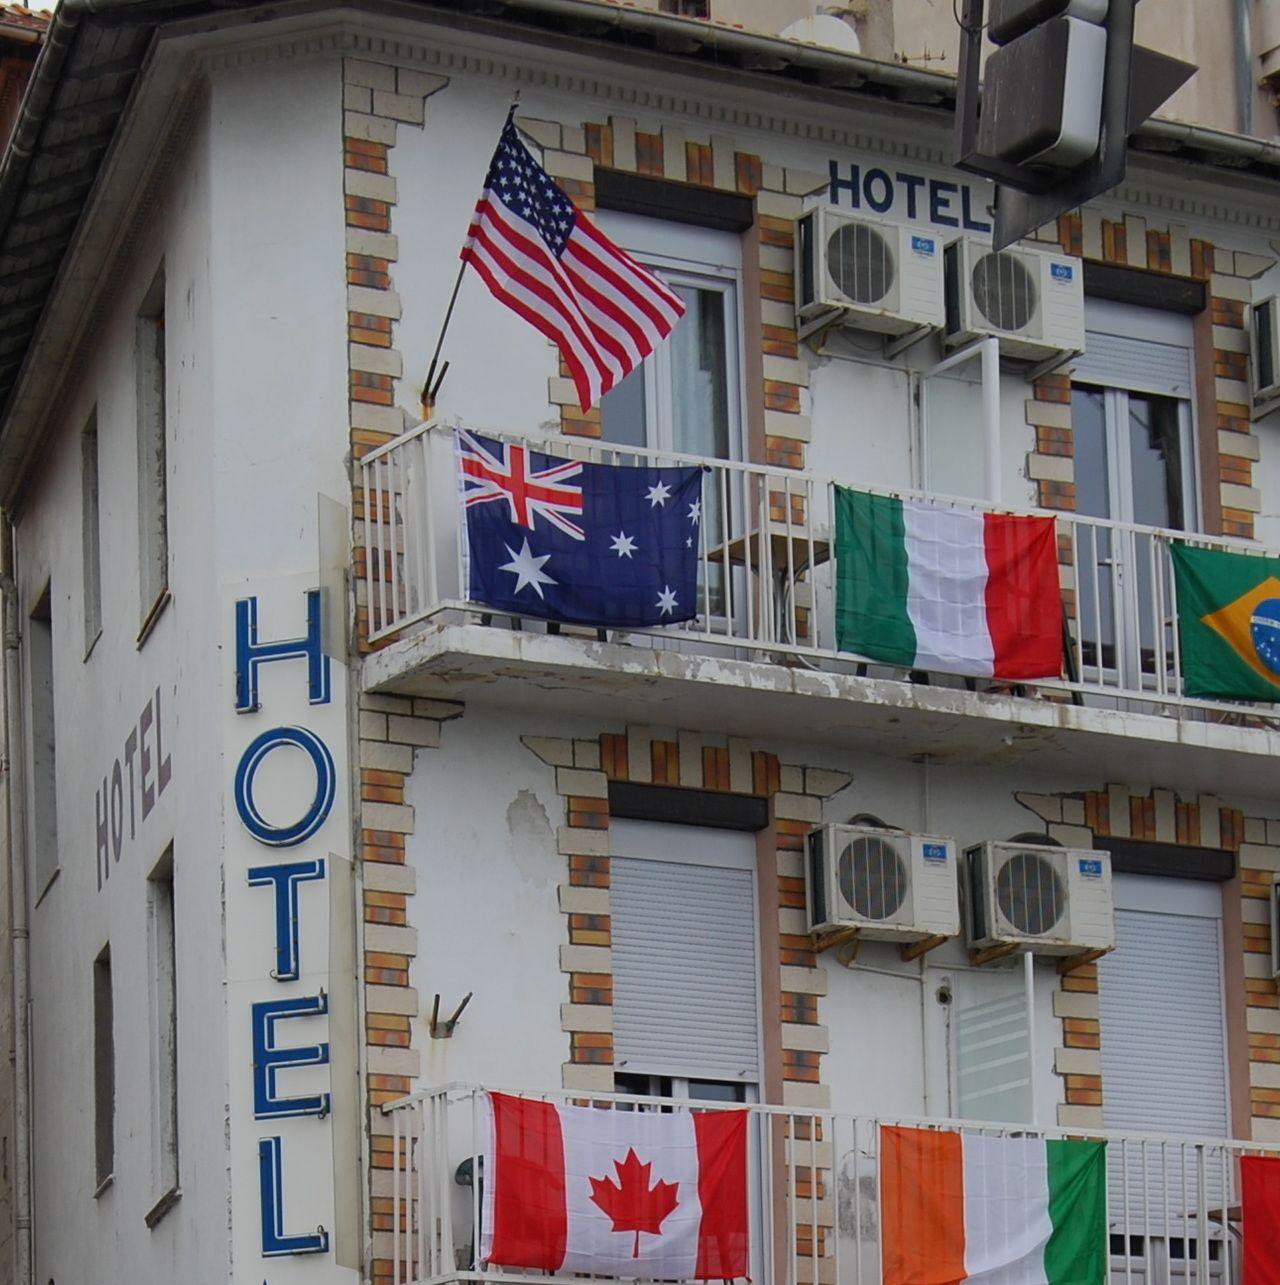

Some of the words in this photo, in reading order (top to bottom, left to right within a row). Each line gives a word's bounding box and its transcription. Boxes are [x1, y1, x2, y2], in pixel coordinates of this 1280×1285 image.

[829, 160, 991, 233] HOTEL
[96, 684, 171, 894] HOTEL
[235, 586, 336, 1257] HOTEL
